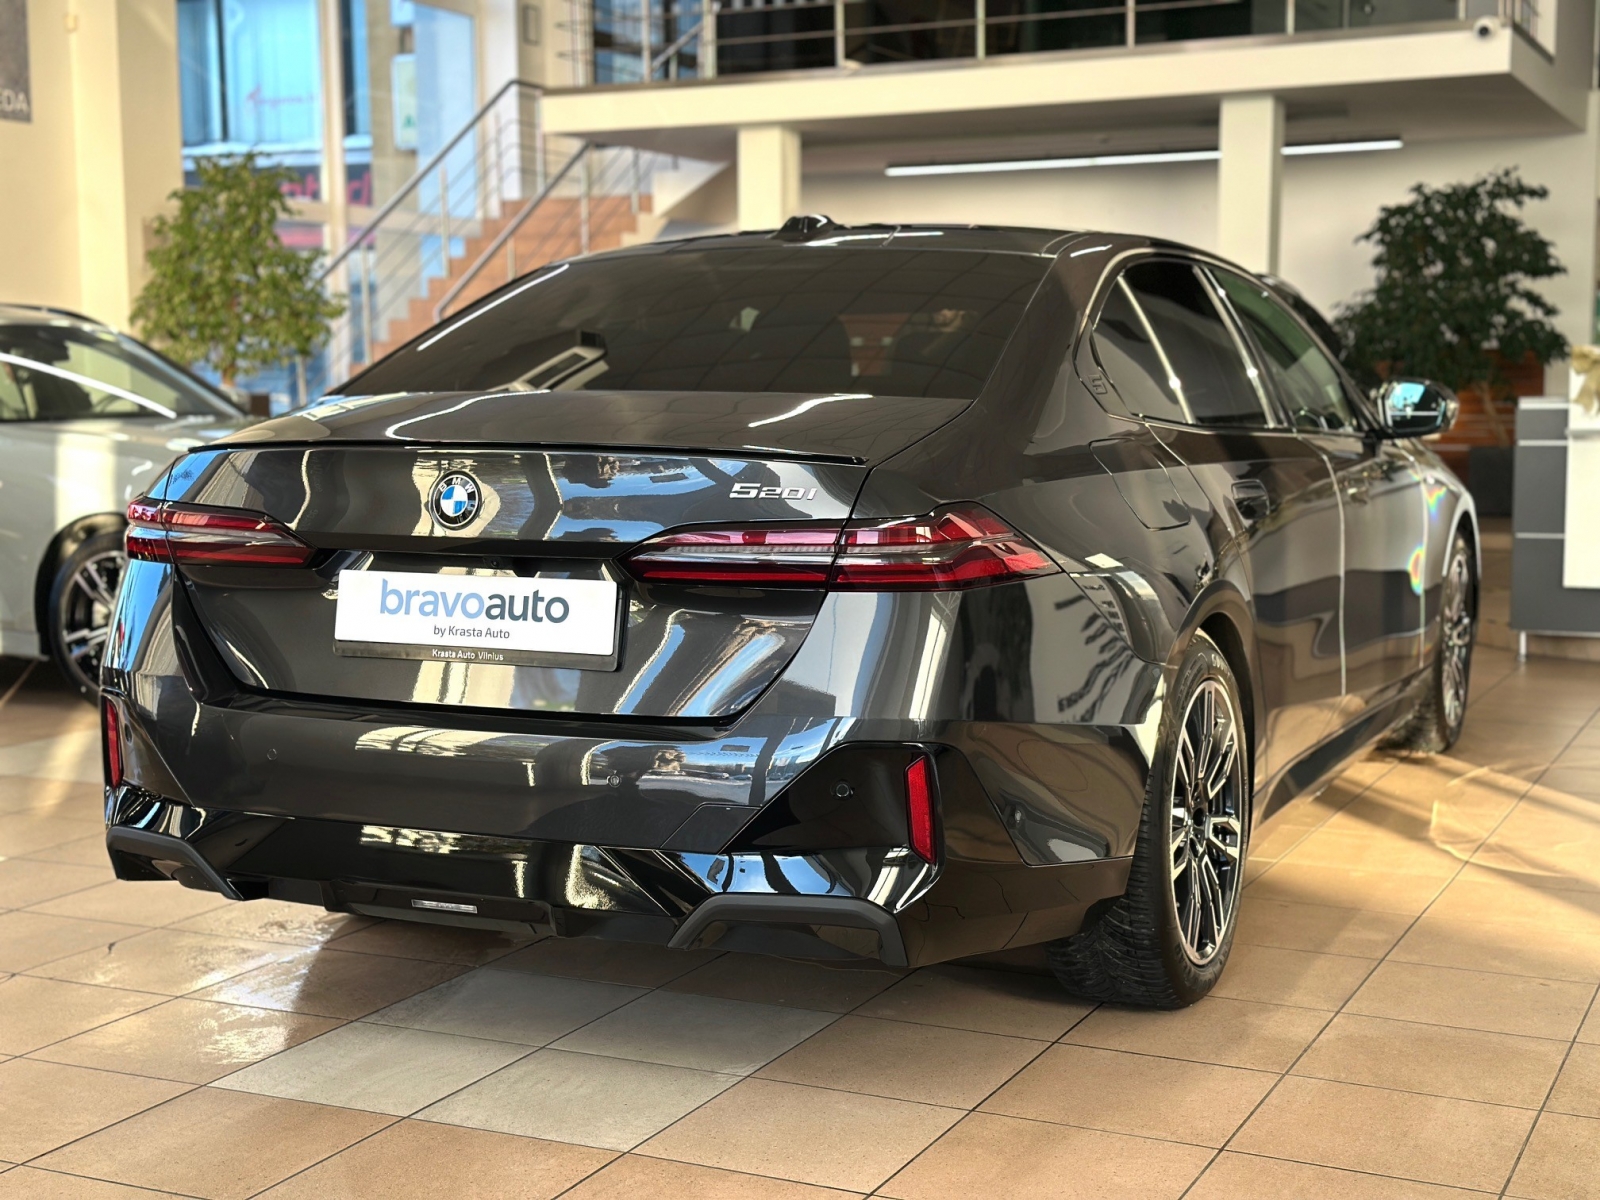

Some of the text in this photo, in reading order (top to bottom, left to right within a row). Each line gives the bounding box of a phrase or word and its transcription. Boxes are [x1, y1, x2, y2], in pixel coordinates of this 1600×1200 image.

[439, 477, 476, 494] BMW
[380, 578, 570, 624] bravoauto
[433, 625, 511, 639] by Krasta Auto
[432, 648, 504, 661] Krasta Auto Vilnius
